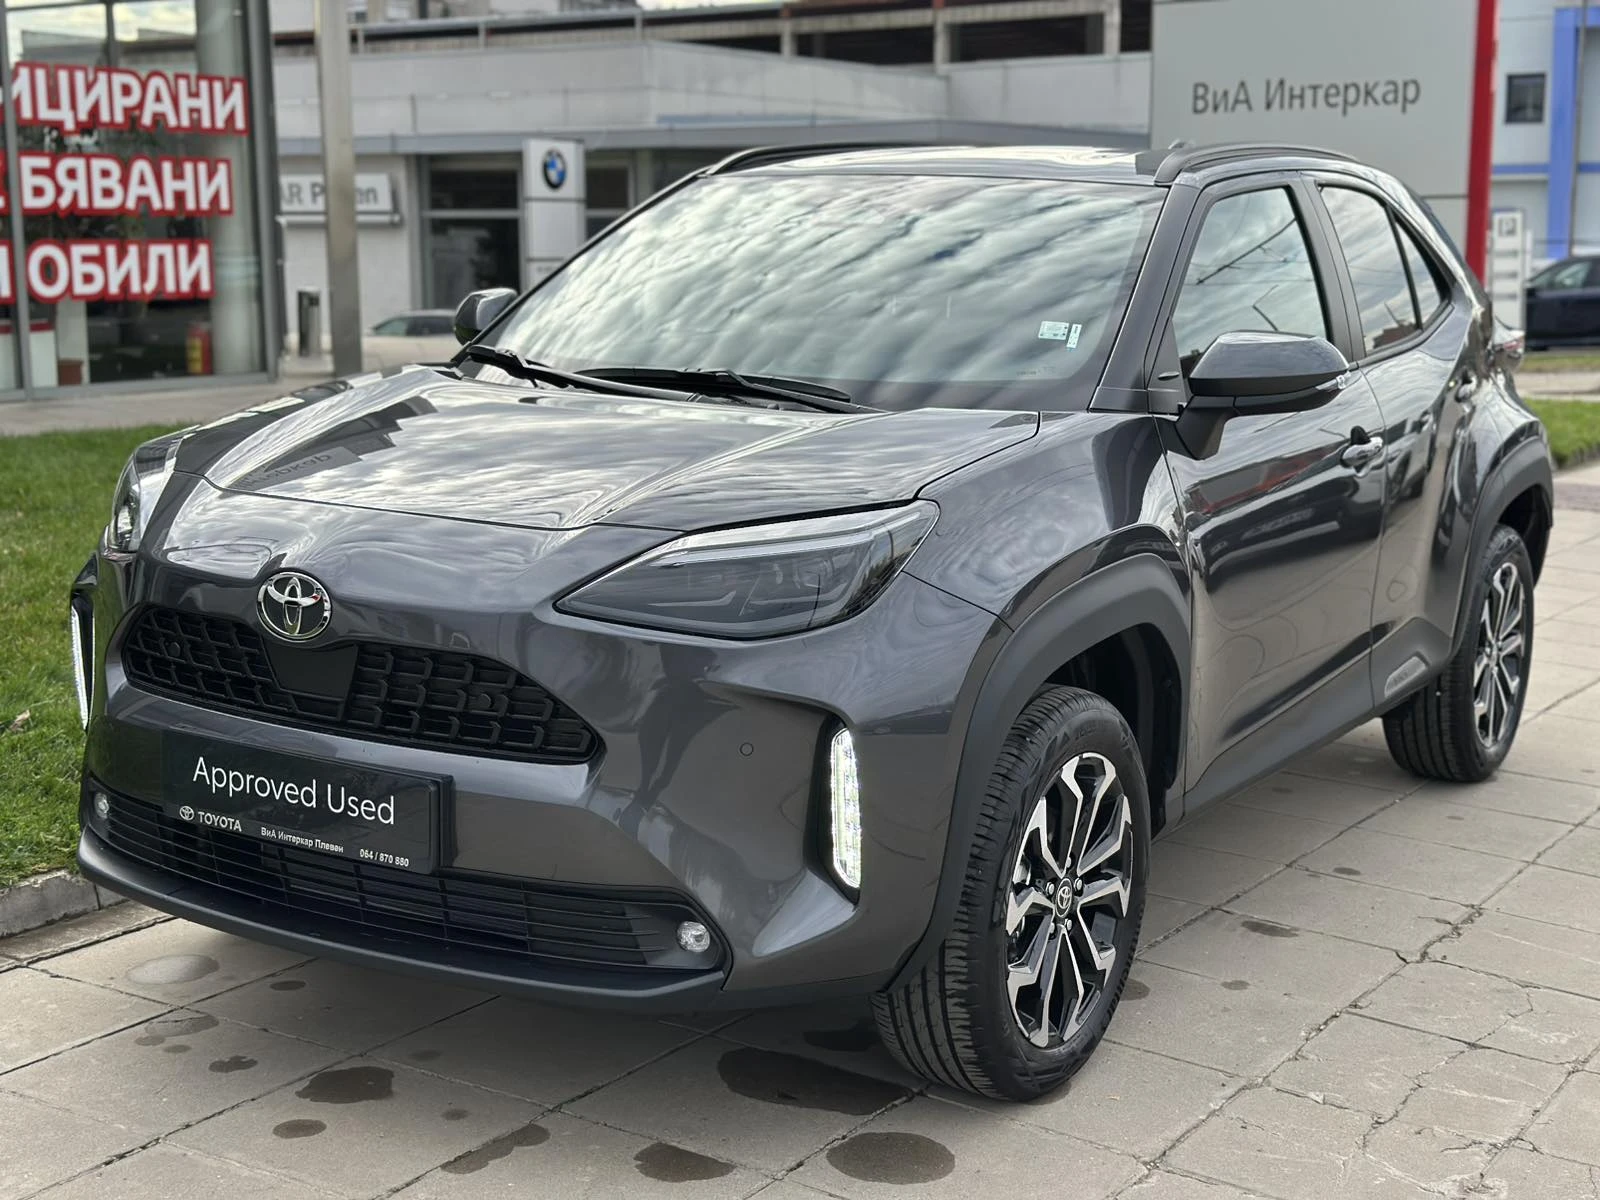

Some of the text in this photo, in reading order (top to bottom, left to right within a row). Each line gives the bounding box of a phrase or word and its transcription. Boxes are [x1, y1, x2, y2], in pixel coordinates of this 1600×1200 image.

[0, 65, 246, 131] ИЦИРАНИ
[1191, 77, 1421, 117] ВиА Интеркар
[0, 155, 232, 212] БЯВАНИ
[193, 756, 395, 825] Approved Used
[198, 811, 242, 833] TOYOTA
[260, 826, 344, 853] ВиА Интеркар Плевен
[359, 848, 374, 860] 064
[379, 852, 394, 864] 870
[394, 856, 410, 867] 880
